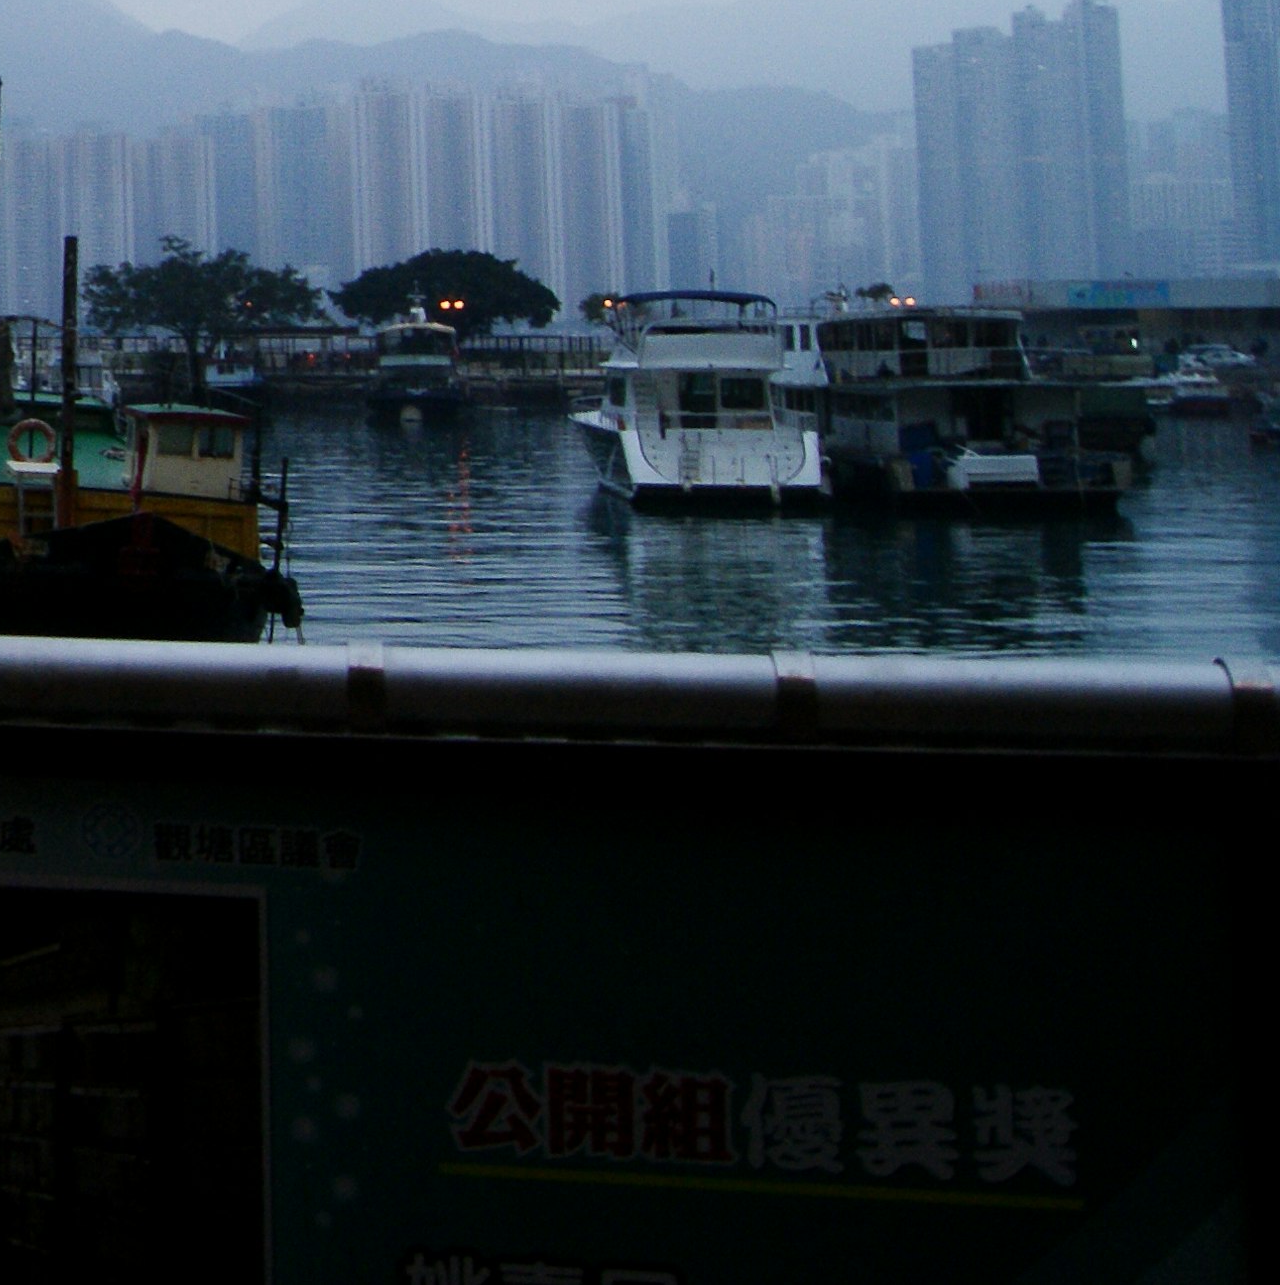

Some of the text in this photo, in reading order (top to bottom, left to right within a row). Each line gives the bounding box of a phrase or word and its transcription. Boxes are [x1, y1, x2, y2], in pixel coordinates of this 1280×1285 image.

[153, 824, 363, 870] 觀塘區議會
[446, 1060, 1080, 1187] 公開組優異獎
